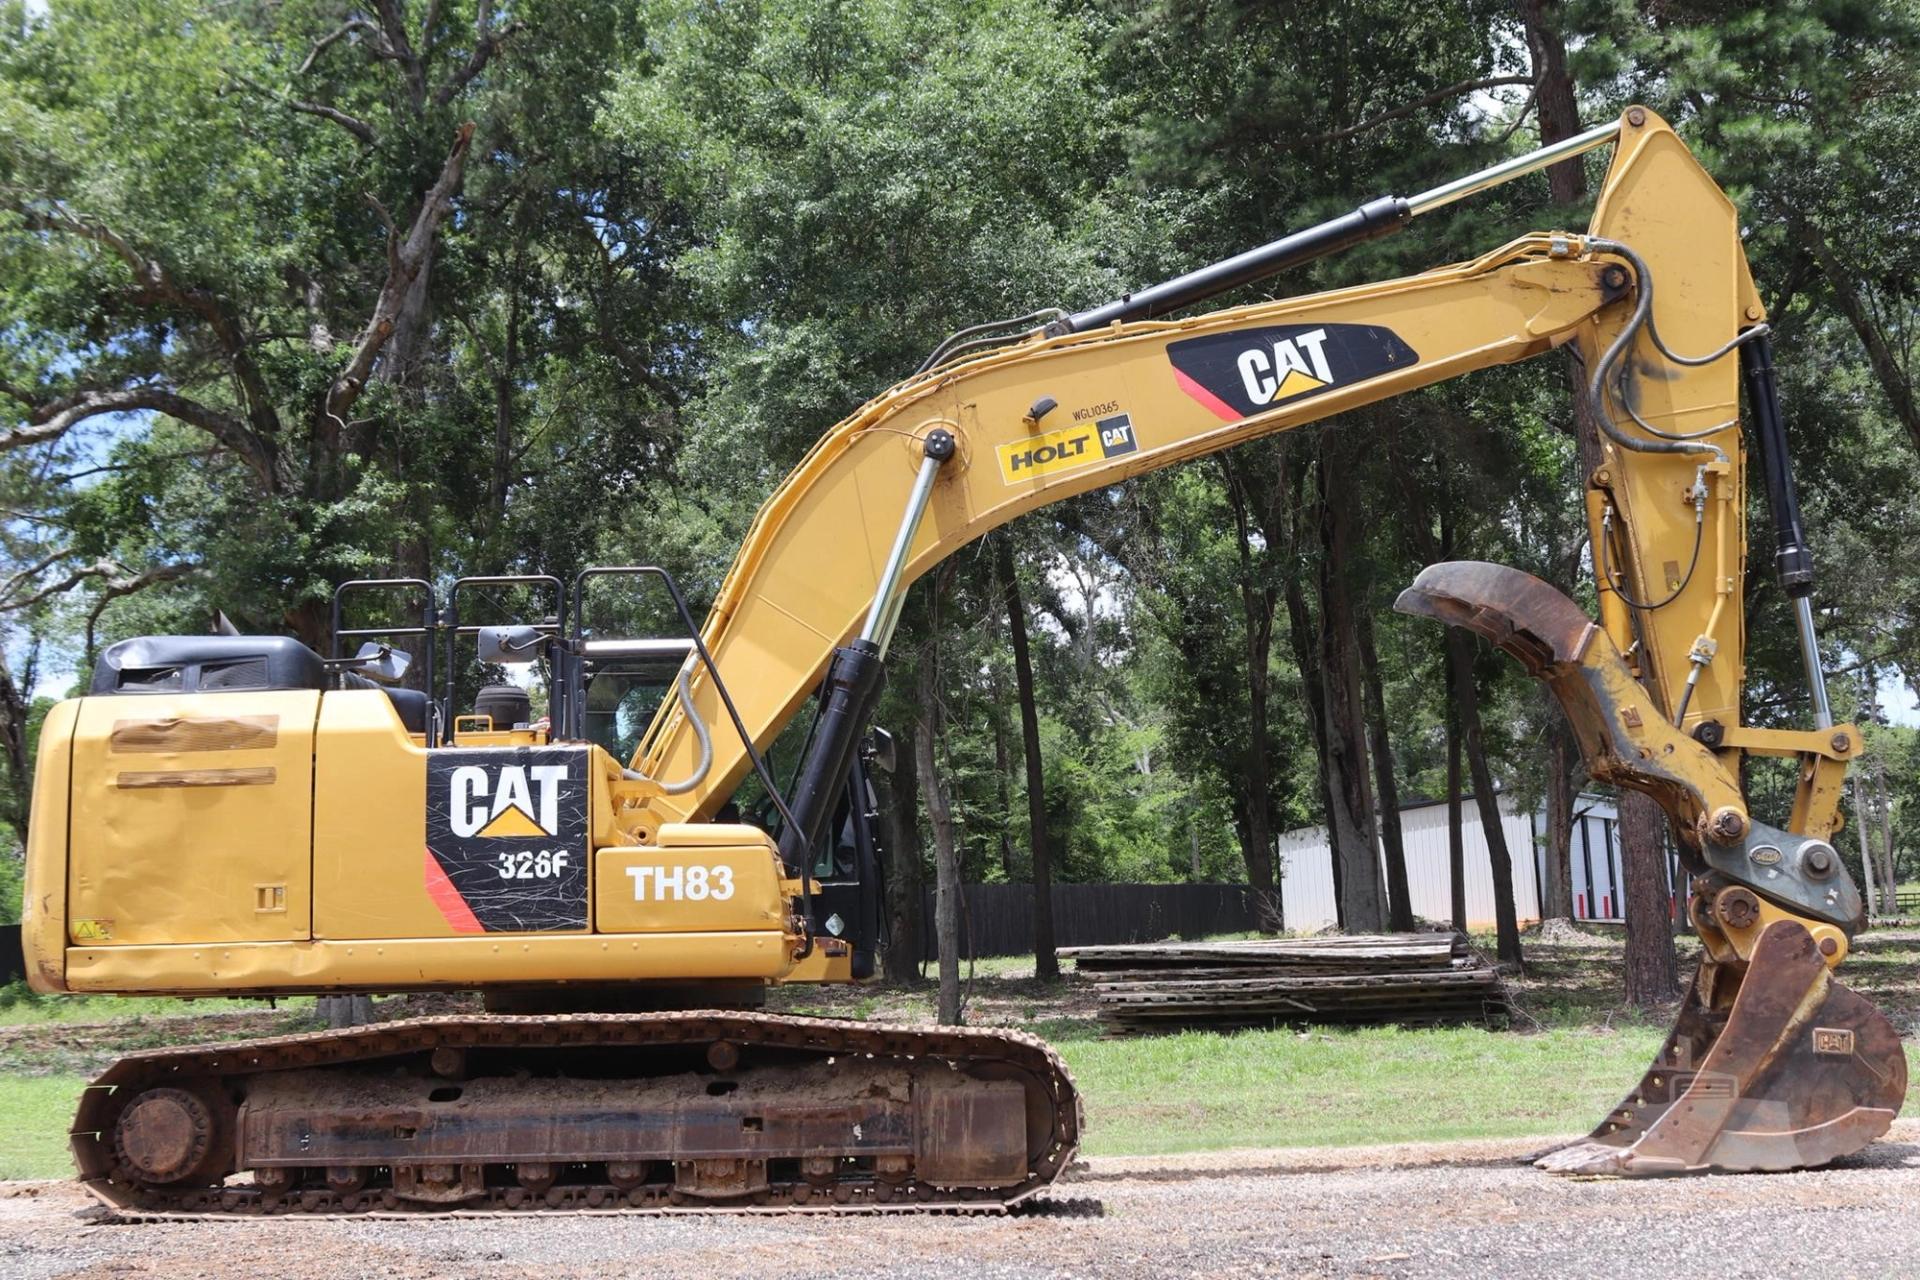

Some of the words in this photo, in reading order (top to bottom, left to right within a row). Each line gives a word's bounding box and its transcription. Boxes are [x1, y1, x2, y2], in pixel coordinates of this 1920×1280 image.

[1237, 329, 1334, 405] CAT
[1072, 400, 1120, 422] WGL10365
[1011, 436, 1090, 471] HOLT
[1102, 425, 1129, 447] CAT
[450, 765, 568, 838] CAT
[499, 850, 569, 880] 326F
[625, 865, 735, 901] TH83
[1818, 1033, 1849, 1051] CAT
